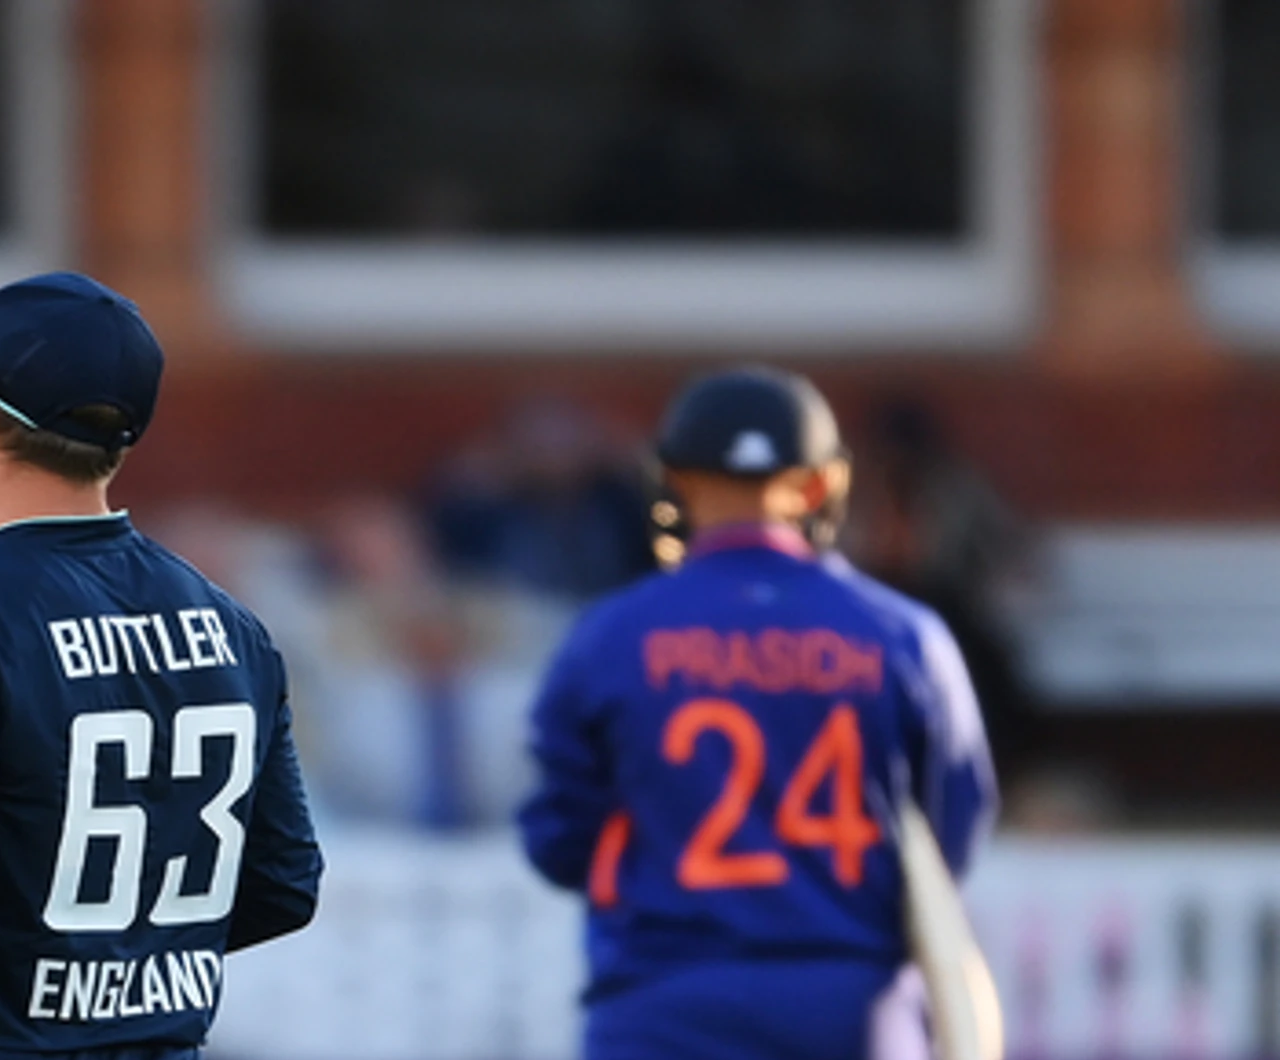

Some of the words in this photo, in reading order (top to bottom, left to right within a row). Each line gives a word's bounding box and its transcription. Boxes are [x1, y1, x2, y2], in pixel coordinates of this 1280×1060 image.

[47, 606, 239, 680] BUTTLER
[42, 701, 257, 932] 63
[658, 696, 884, 890] 24
[27, 948, 223, 1021] ENGLAND
